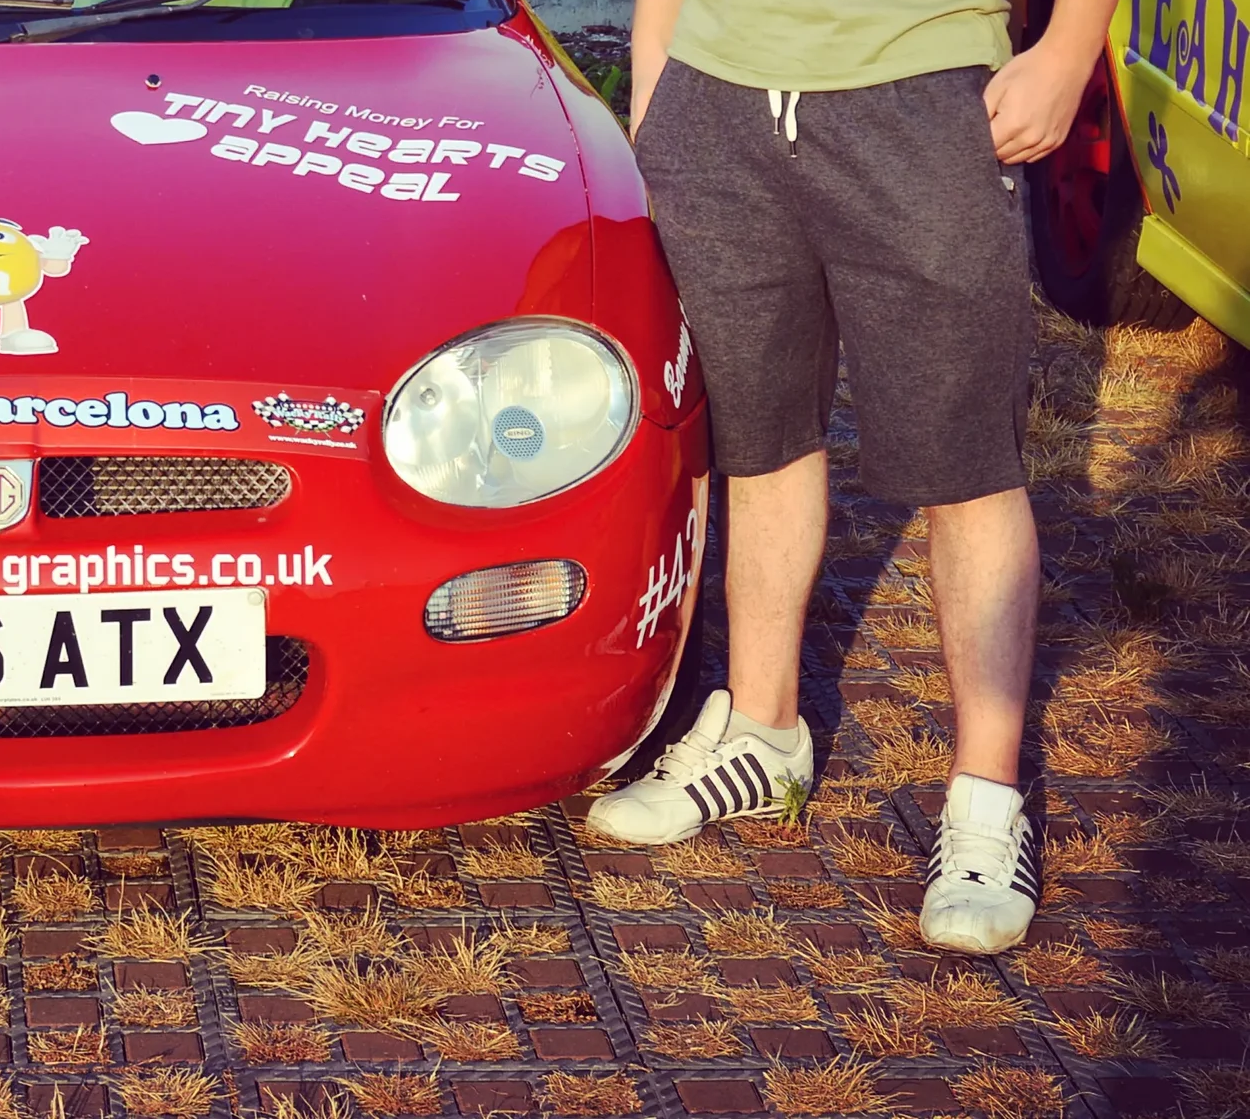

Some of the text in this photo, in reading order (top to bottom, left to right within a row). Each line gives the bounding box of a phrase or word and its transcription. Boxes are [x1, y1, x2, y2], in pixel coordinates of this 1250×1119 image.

[244, 83, 485, 131] Raising Money For
[2, 544, 333, 595] graphics.co.uk
[39, 605, 215, 690] ATX
